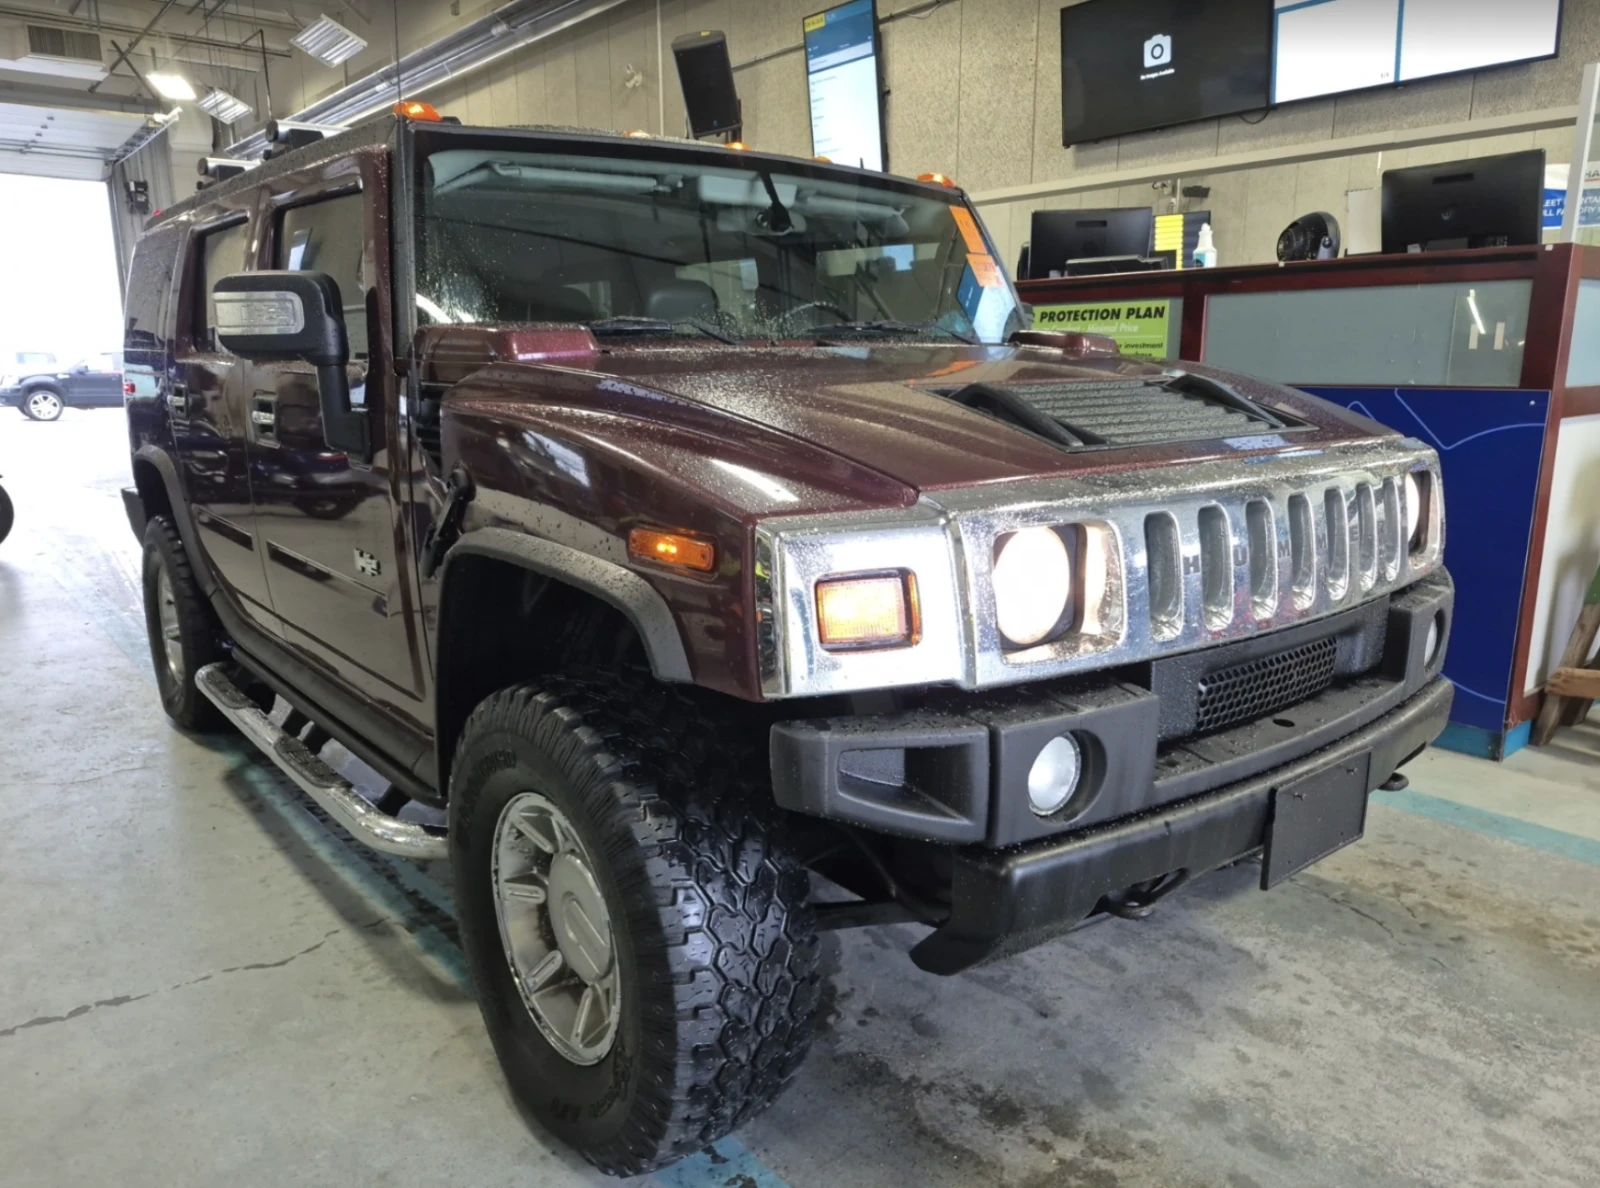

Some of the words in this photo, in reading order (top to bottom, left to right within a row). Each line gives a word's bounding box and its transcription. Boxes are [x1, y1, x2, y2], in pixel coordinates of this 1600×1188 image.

[1039, 307, 1122, 323] PROTECTION
[1126, 306, 1165, 320] PLAN
[1087, 322, 1118, 333] Minimal
[1120, 321, 1139, 333] Price
[1124, 341, 1163, 349] investment
